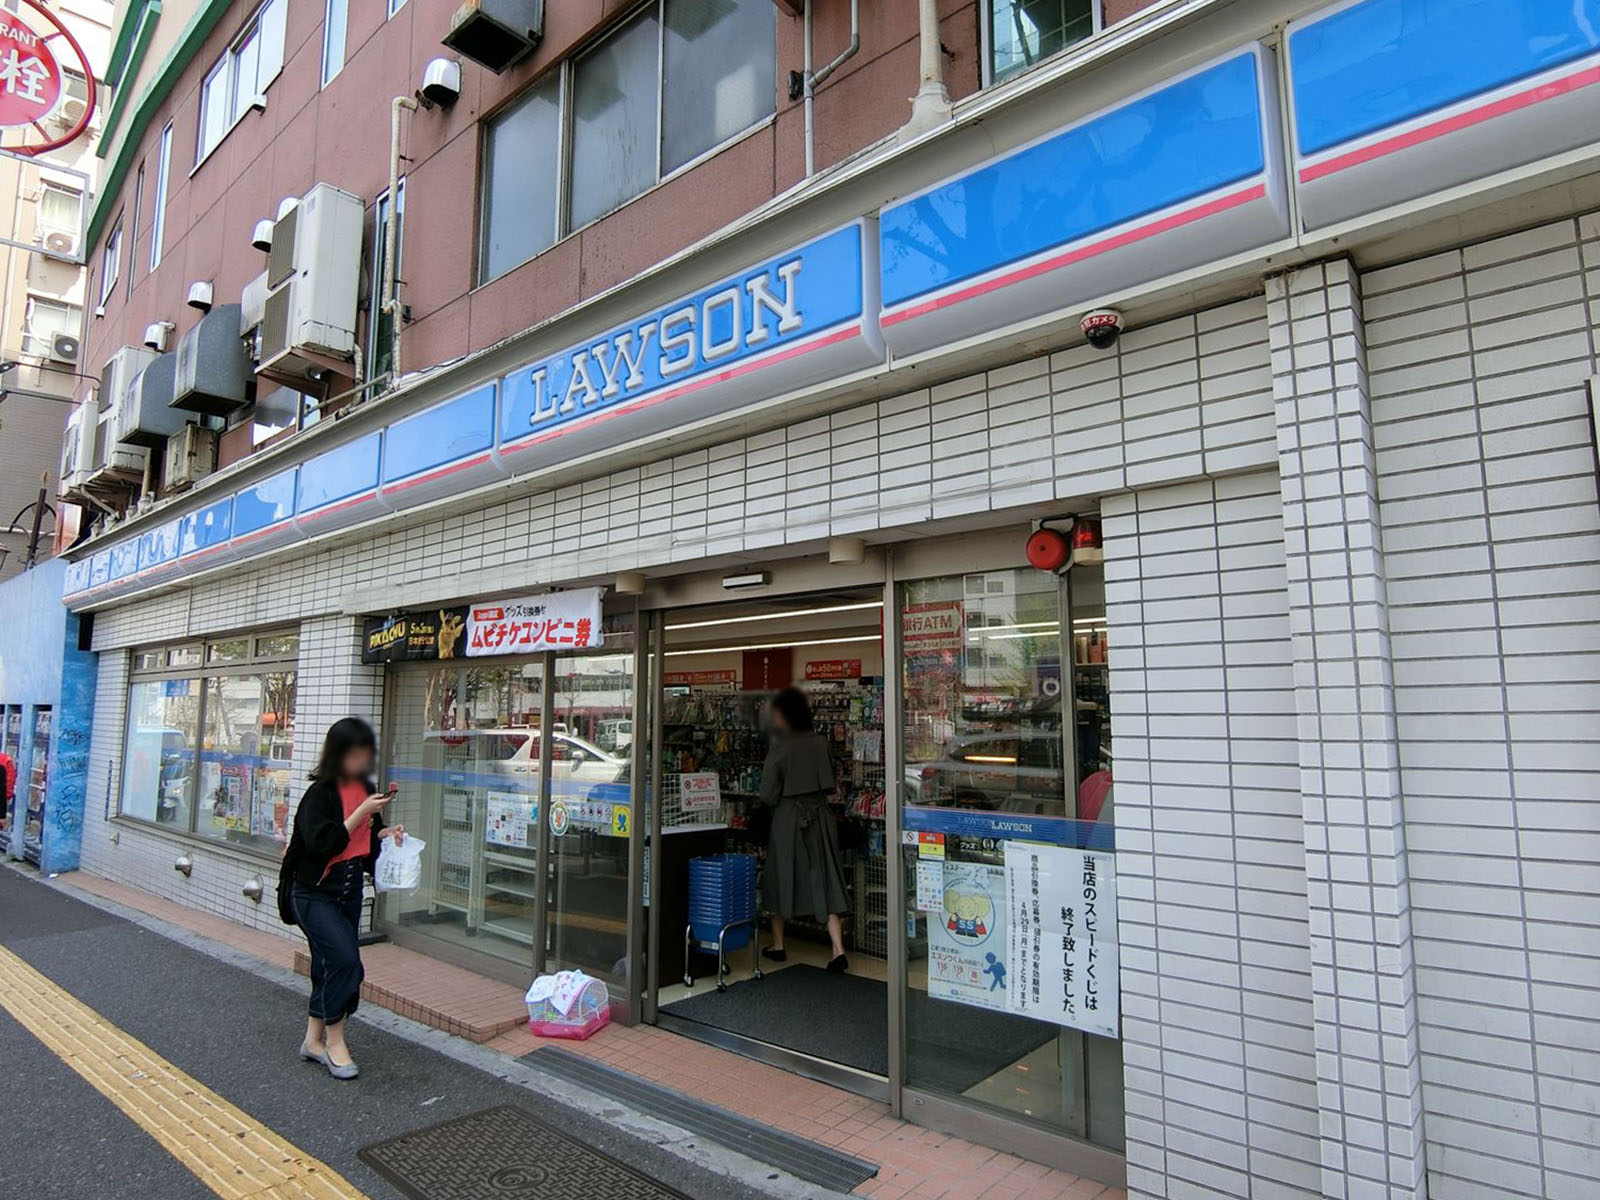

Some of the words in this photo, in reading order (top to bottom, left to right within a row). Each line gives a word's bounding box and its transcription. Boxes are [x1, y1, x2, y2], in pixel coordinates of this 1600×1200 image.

[0, 48, 51, 105] 栓
[530, 257, 803, 426] LAWSON
[370, 620, 406, 649] PIKACHU
[471, 618, 592, 648] ムビチケコンビニ券
[991, 819, 1033, 832] LAWSON
[959, 918, 974, 930] SS
[1082, 855, 1099, 1011] 当店のスピードくじは
[1060, 906, 1077, 1021] 終了致しました。
